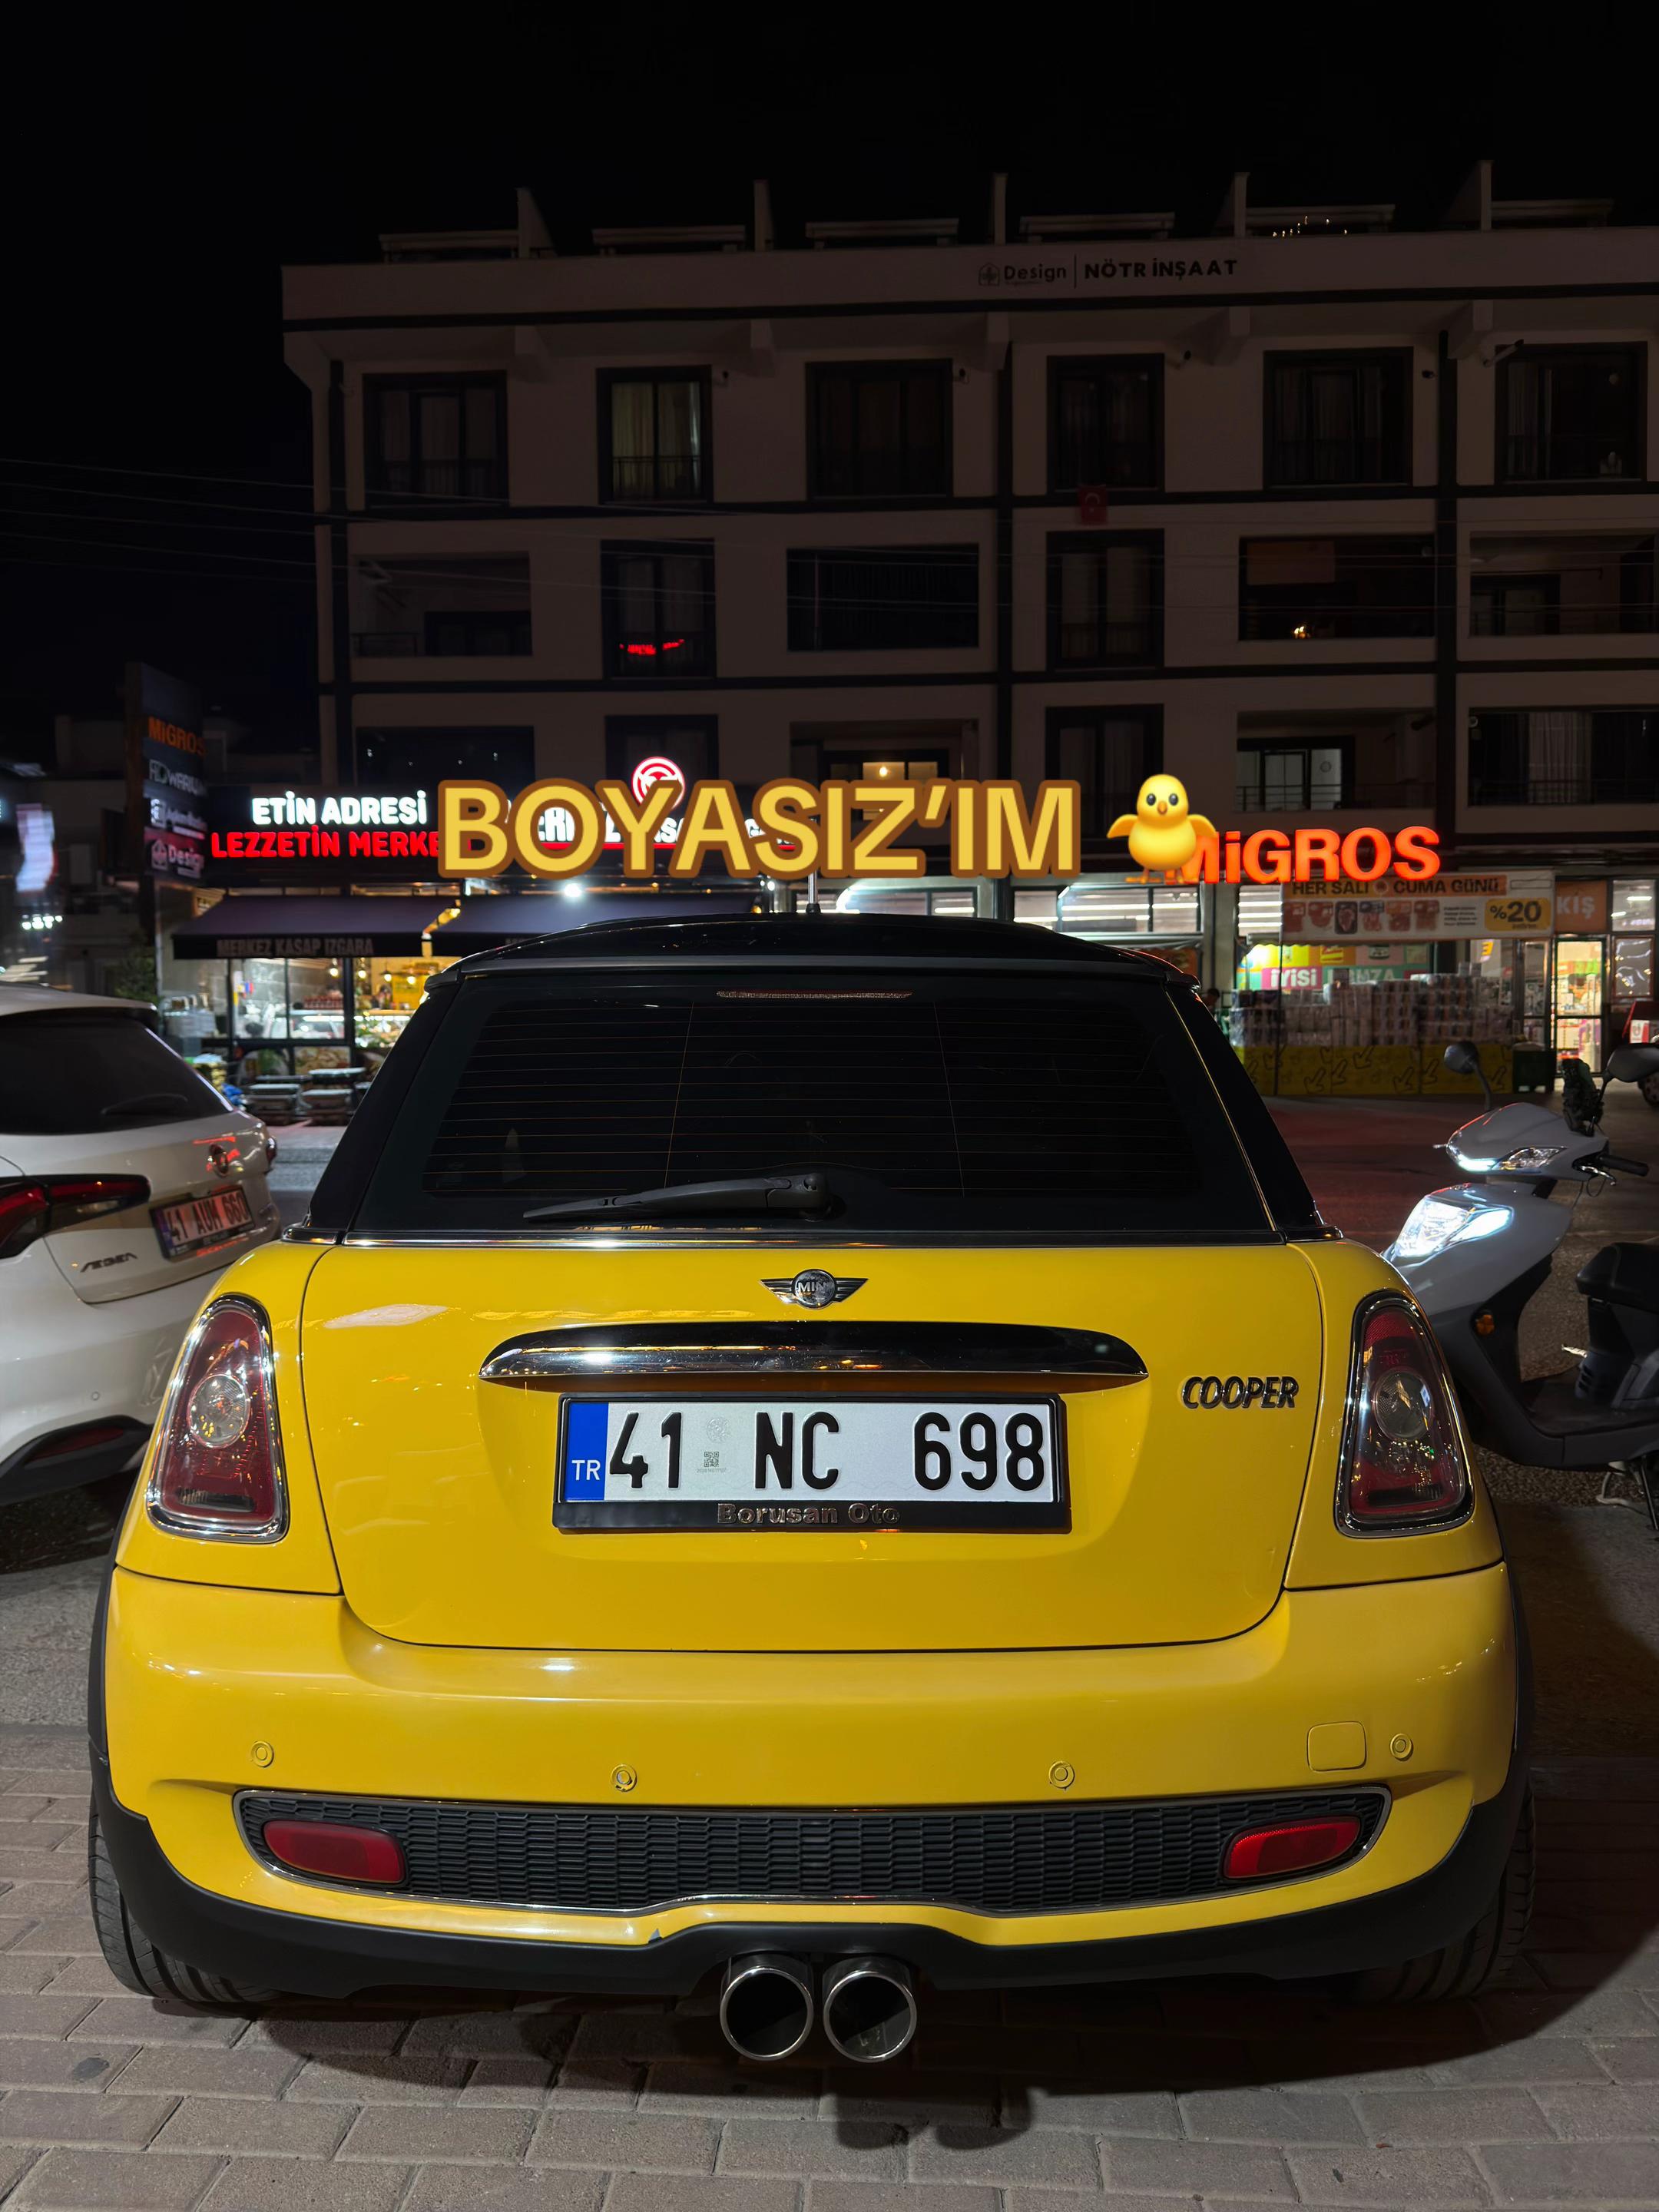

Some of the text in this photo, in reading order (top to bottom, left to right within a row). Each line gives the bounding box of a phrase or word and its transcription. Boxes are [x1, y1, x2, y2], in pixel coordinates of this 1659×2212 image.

[1005, 257, 1237, 283] Design NÖTR İNŞAAT
[251, 790, 428, 825] ETİN ADRESİ
[211, 825, 340, 858] LEZZETİN
[349, 830, 439, 858] MERKE
[1292, 877, 1500, 894] HER SALI CUMA GÜNÜ
[1490, 900, 1541, 922] %20
[1557, 896, 1595, 919] KIŞ
[216, 937, 374, 958] MERKEZ KASAP IZGARA
[797, 1280, 830, 1293] MIN
[1182, 1376, 1300, 1409] COOPER
[572, 1412, 1045, 1492] TR 41 NC 698
[717, 1502, 901, 1525] Borusan Oto
